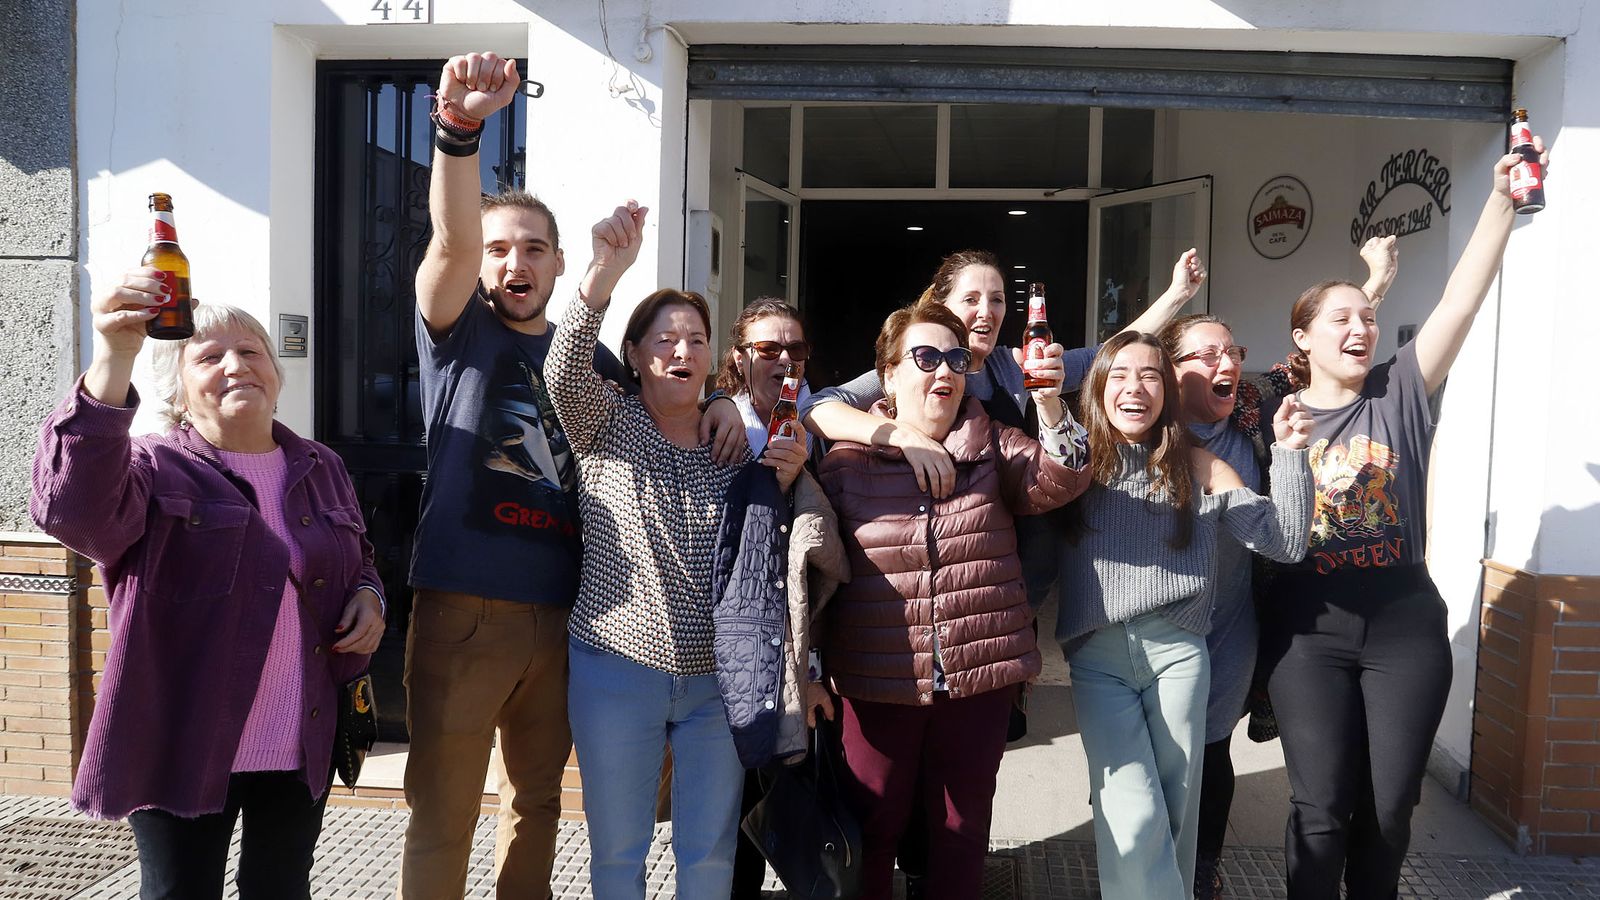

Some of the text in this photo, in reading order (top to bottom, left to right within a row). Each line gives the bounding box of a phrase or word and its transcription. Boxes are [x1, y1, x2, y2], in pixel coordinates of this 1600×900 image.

[371, 0, 424, 20] 44
[1256, 208, 1302, 227] SAIMAZA
[1350, 180, 1381, 247] BAR
[1366, 201, 1433, 239] DESDE 1948
[494, 501, 573, 535] GREM
